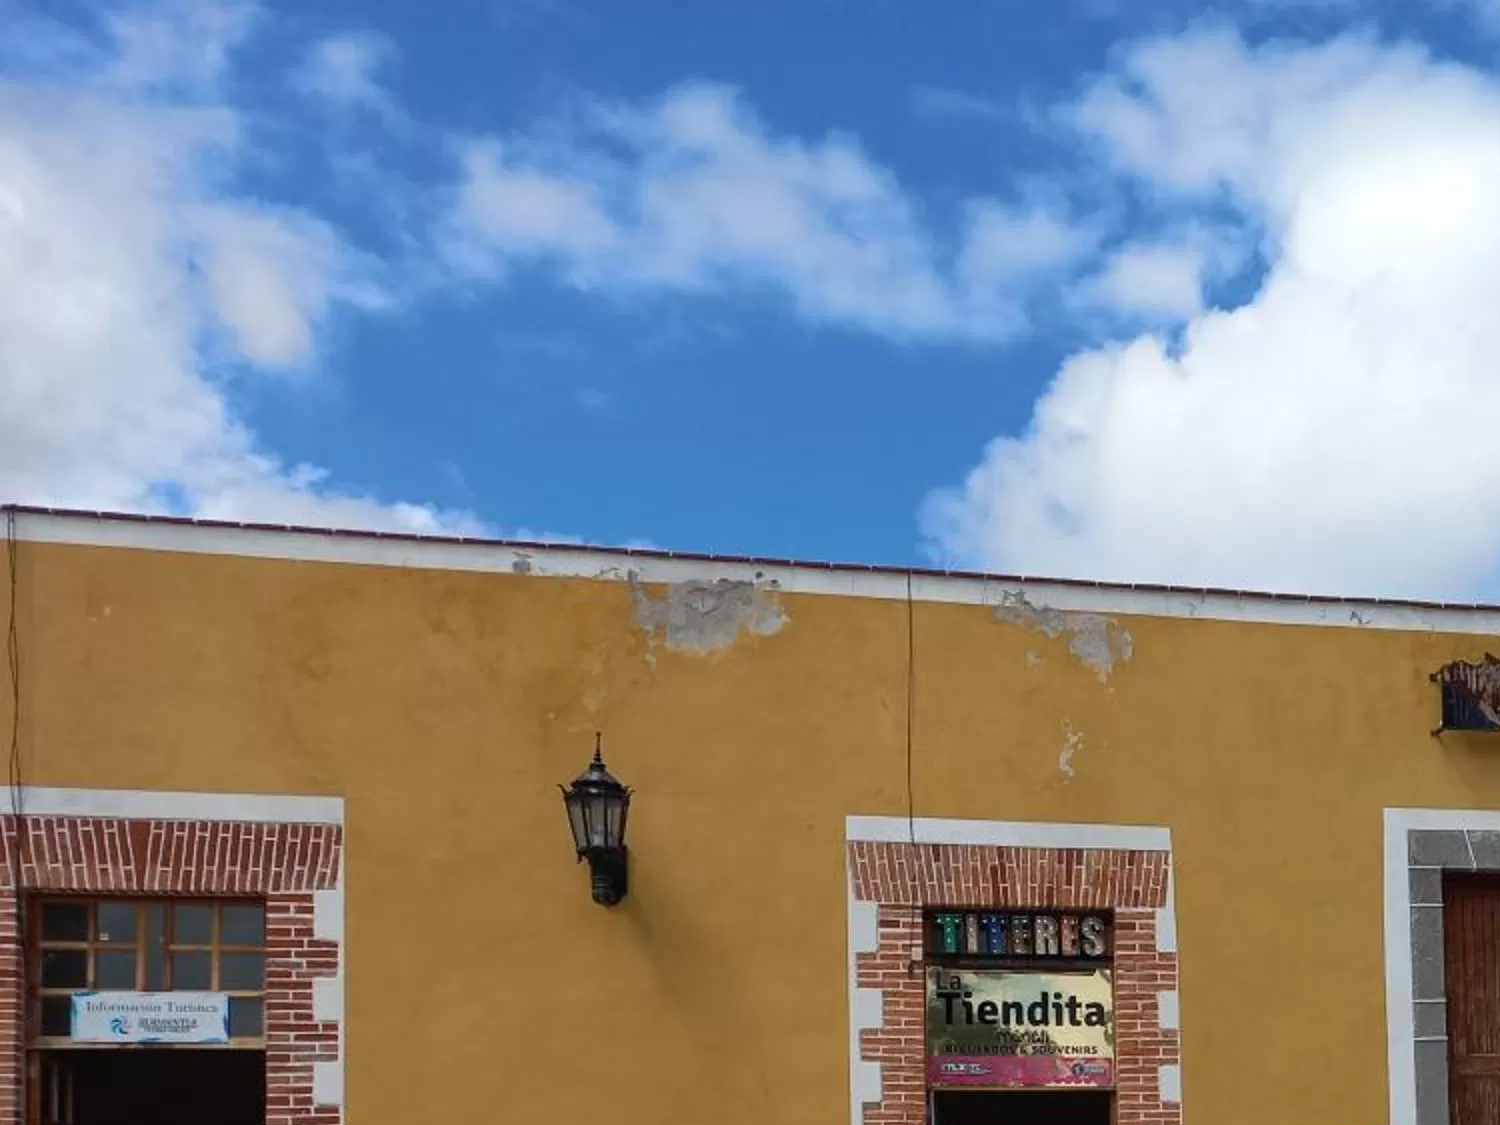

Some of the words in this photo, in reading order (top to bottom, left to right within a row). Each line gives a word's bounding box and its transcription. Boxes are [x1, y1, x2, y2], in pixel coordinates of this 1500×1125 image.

[933, 914, 1106, 957] TITERES
[935, 971, 963, 991] La
[935, 991, 1107, 1027] Tiendita
[1030, 1045, 1099, 1055] SOUVENIRS
